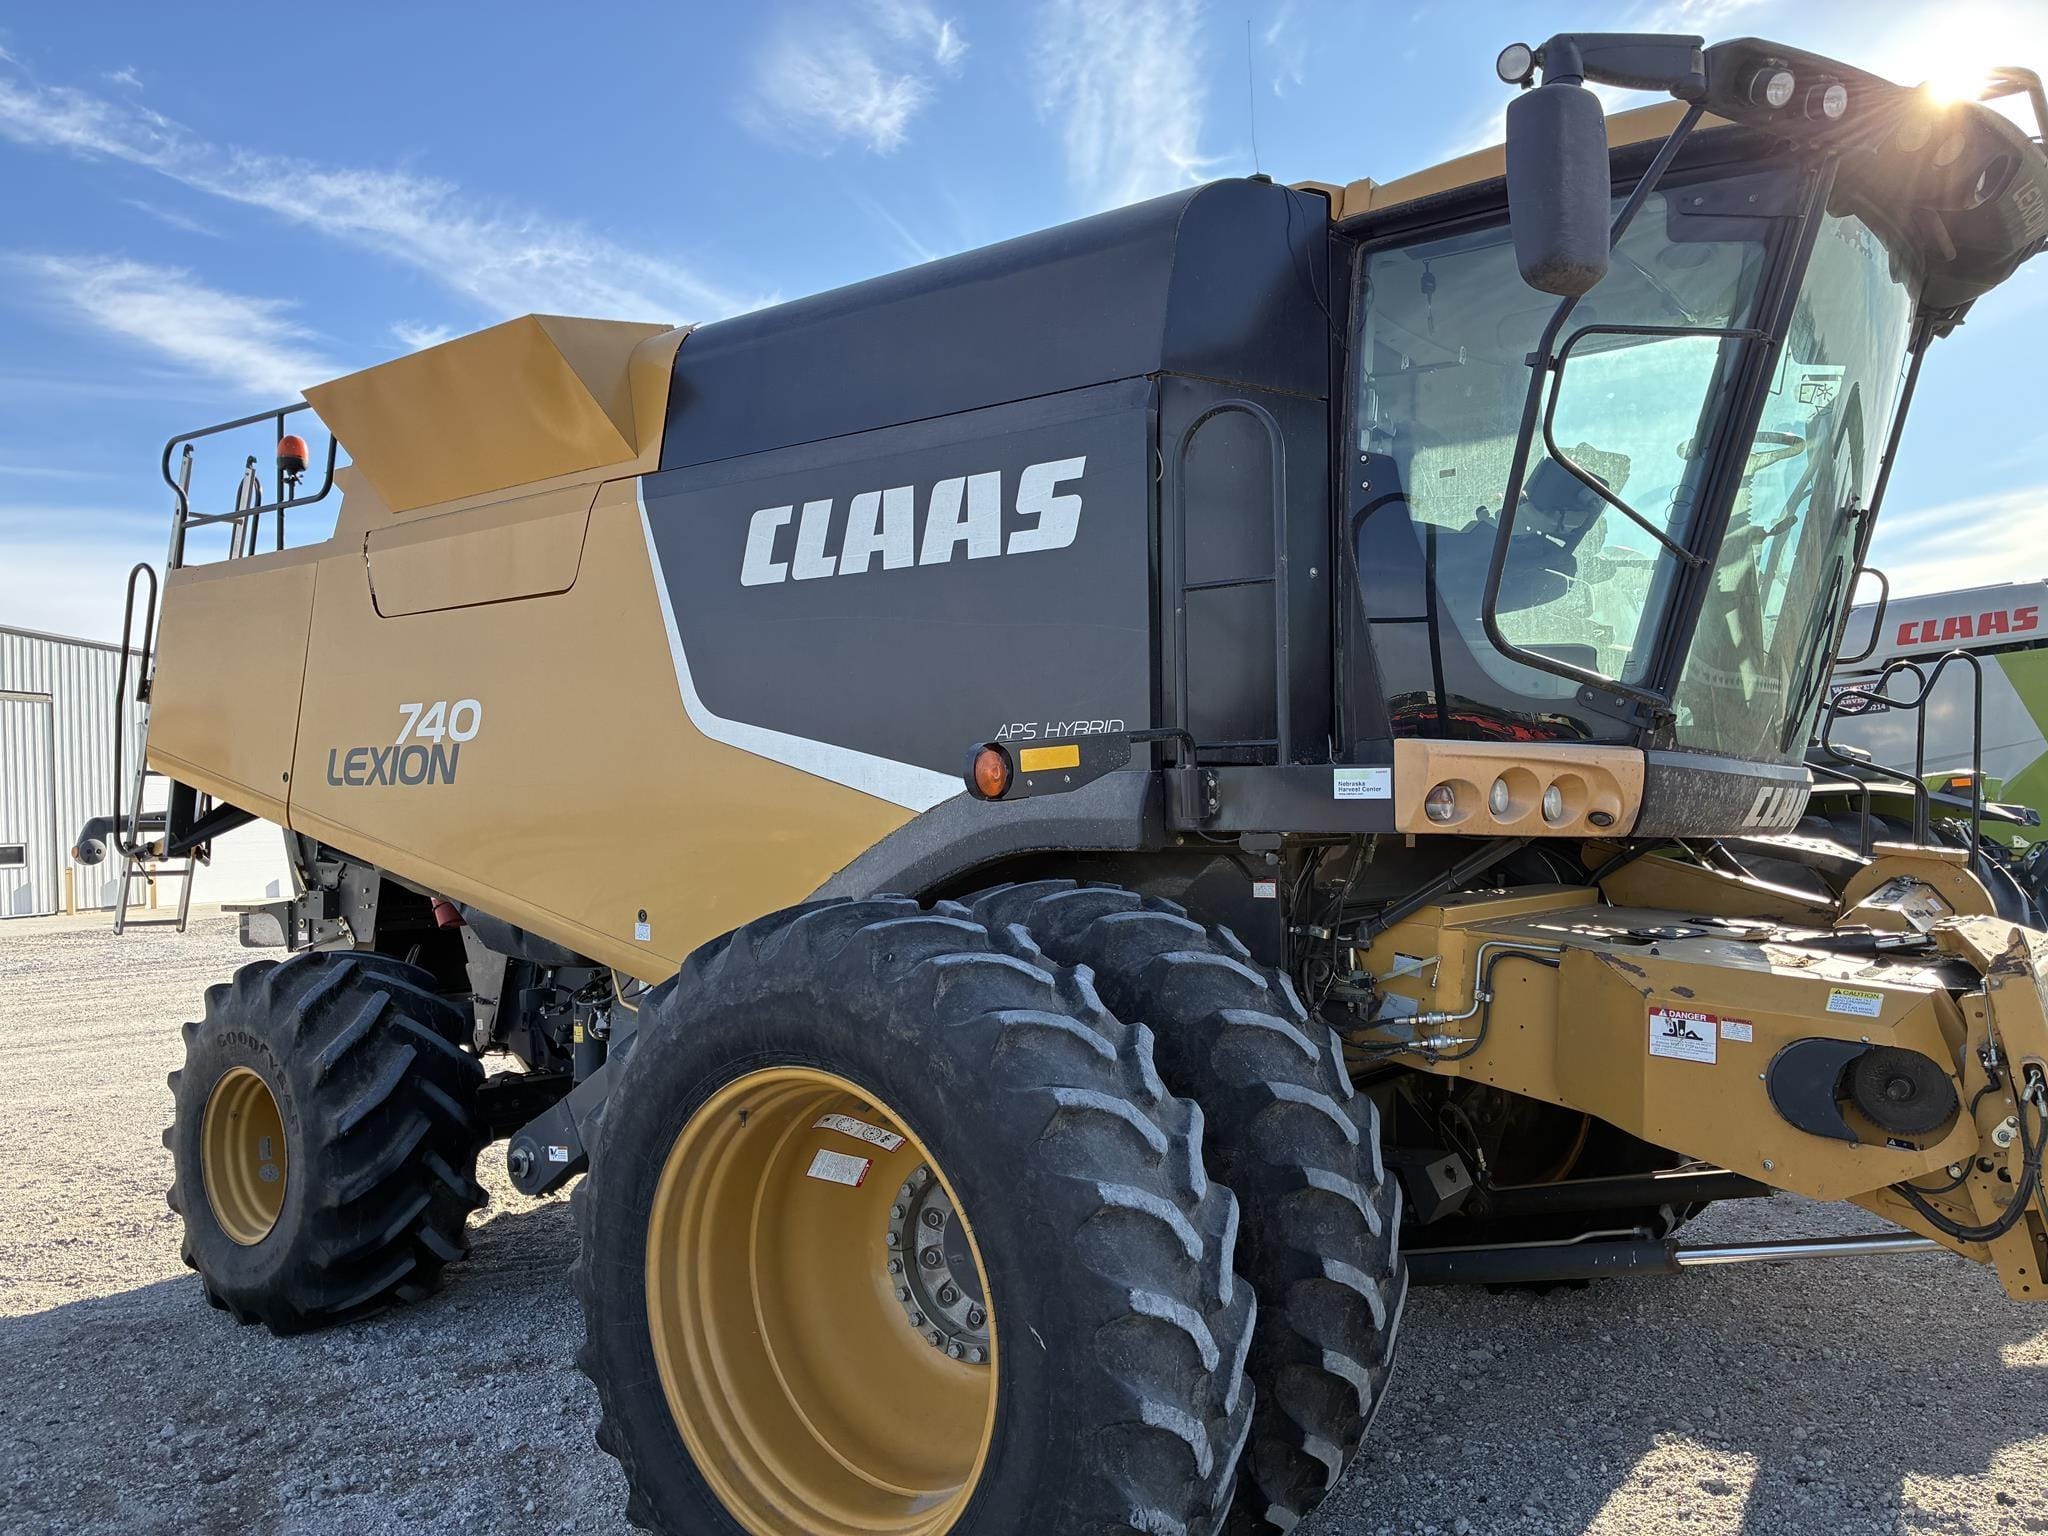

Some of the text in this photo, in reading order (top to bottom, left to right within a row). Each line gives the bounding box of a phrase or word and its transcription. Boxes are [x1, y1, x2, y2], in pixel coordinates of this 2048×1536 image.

[740, 455, 1087, 587] CLAAS
[1896, 606, 2039, 646] CLAAS
[395, 698, 482, 745] 740
[994, 719, 1125, 740] APS HYBRID
[326, 743, 460, 786] LEXION
[1842, 990, 1880, 999] CAUTION
[1668, 1010, 1707, 1021] DANGER
